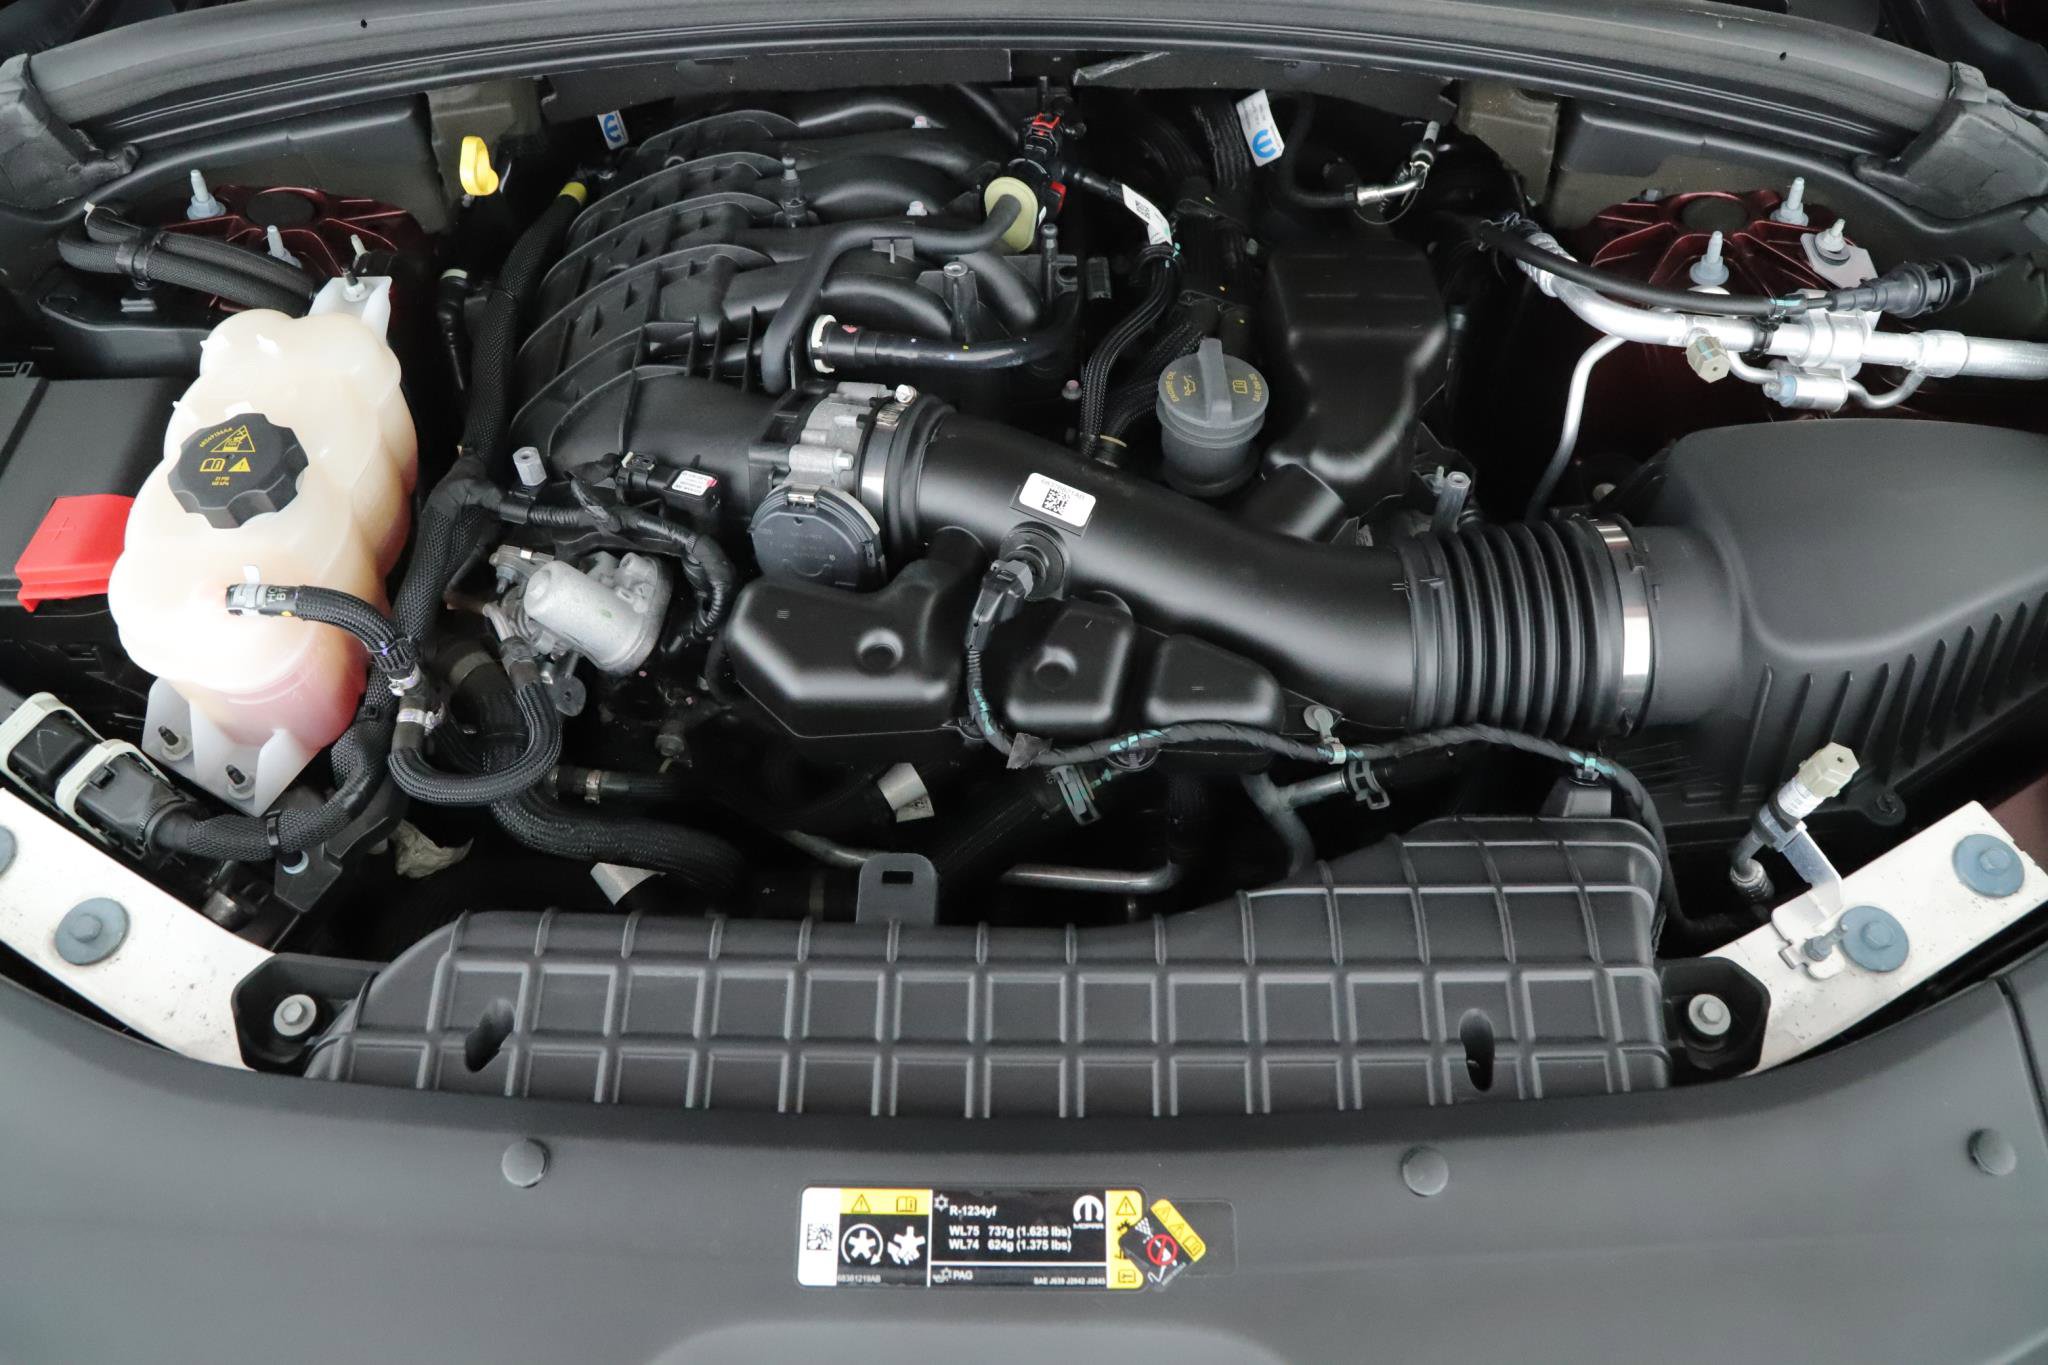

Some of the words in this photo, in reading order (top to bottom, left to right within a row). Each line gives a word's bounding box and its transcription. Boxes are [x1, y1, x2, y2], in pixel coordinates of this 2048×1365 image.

[949, 1204, 997, 1219] R-1234yf
[949, 1225, 980, 1238] WL75
[988, 1226, 1014, 1240] 737g
[1016, 1225, 1049, 1240] (1.625
[1051, 1225, 1072, 1240] lbs)
[949, 1238, 980, 1251] WL74
[987, 1239, 1014, 1253] 624g
[1016, 1239, 1049, 1253] (1.375
[1051, 1239, 1072, 1253] lbs)
[952, 1269, 974, 1281] PAG
